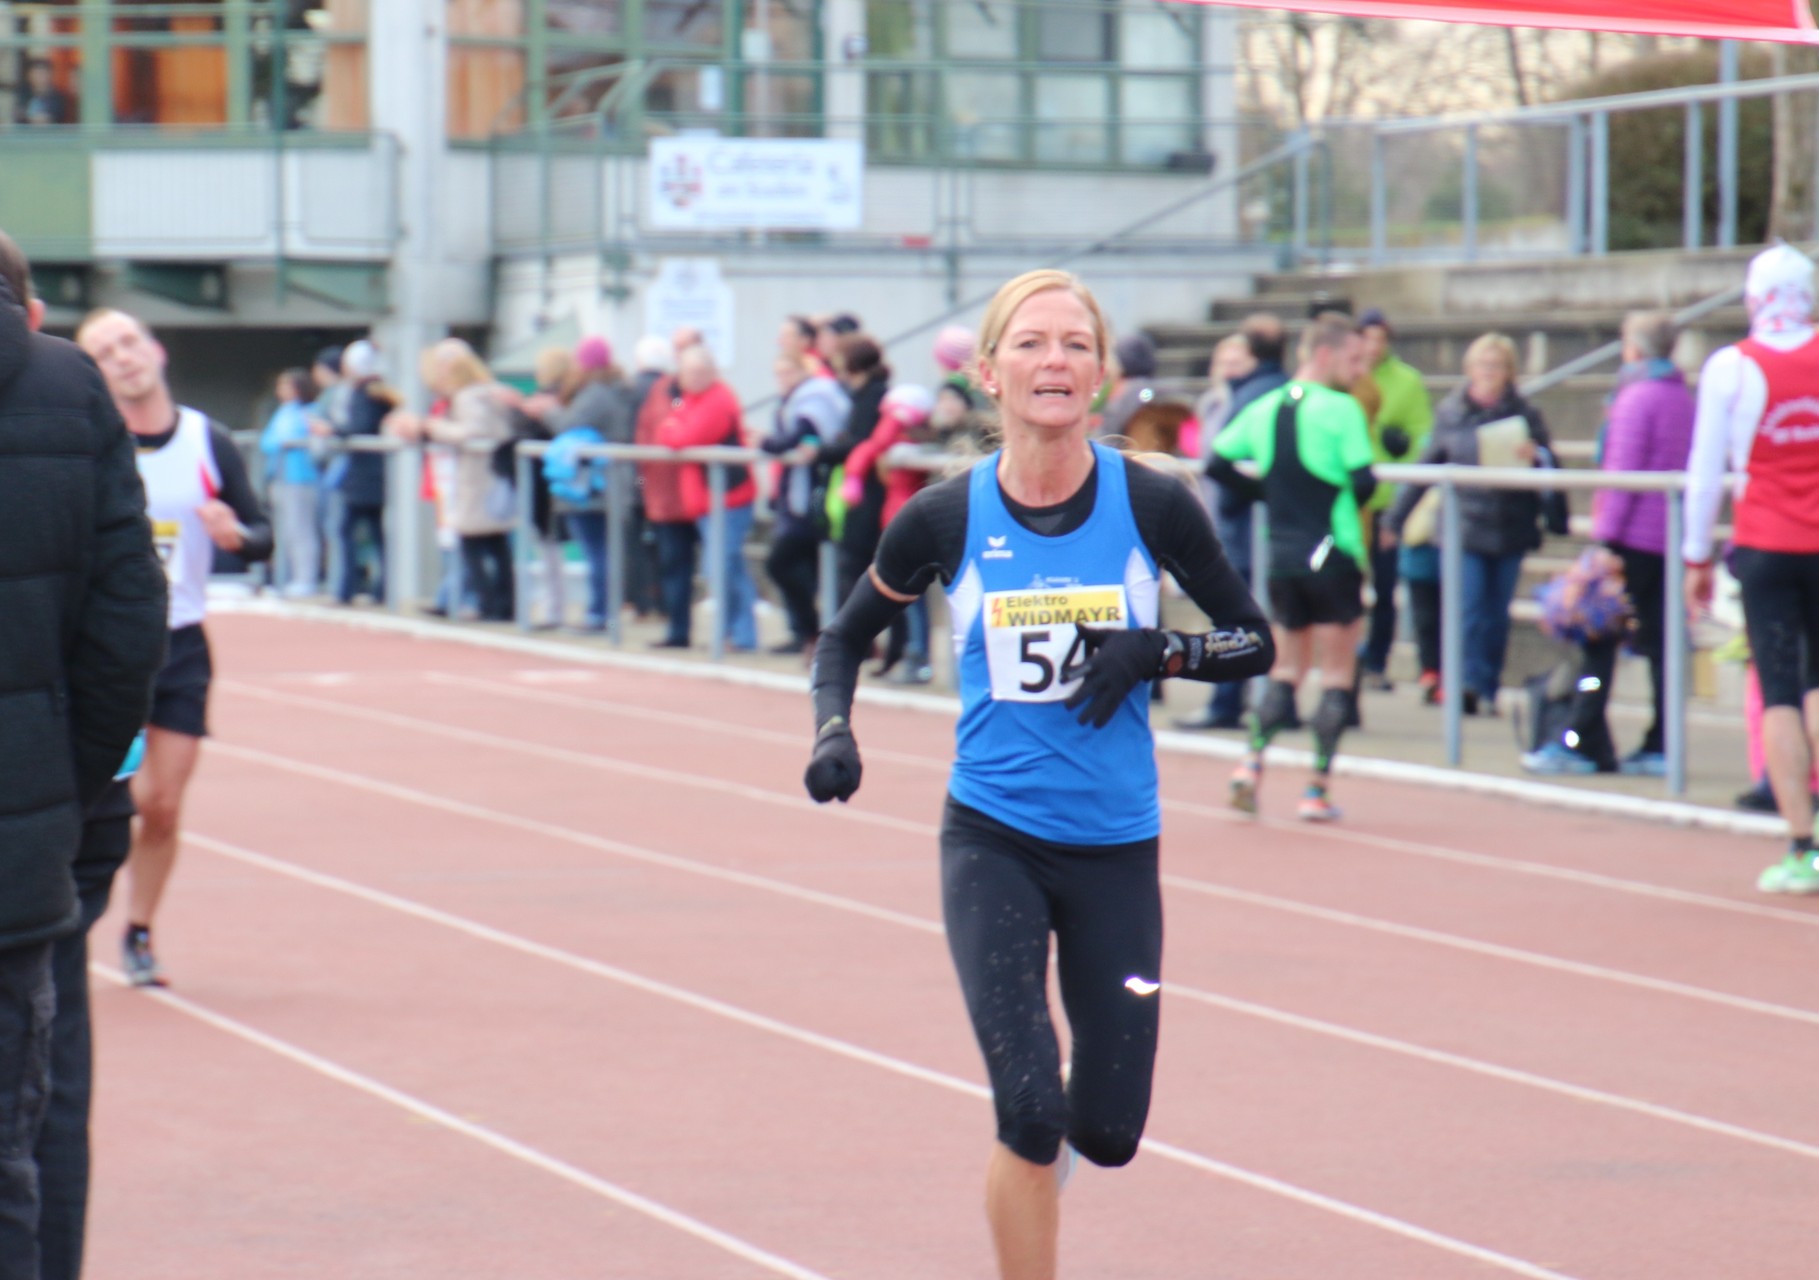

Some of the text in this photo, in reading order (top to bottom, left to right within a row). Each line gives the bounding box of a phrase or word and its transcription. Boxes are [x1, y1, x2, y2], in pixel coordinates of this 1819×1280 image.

[1006, 595, 1068, 608] Elektro
[1008, 606, 1122, 627] WIDMAYR
[1019, 630, 1094, 694] 54
